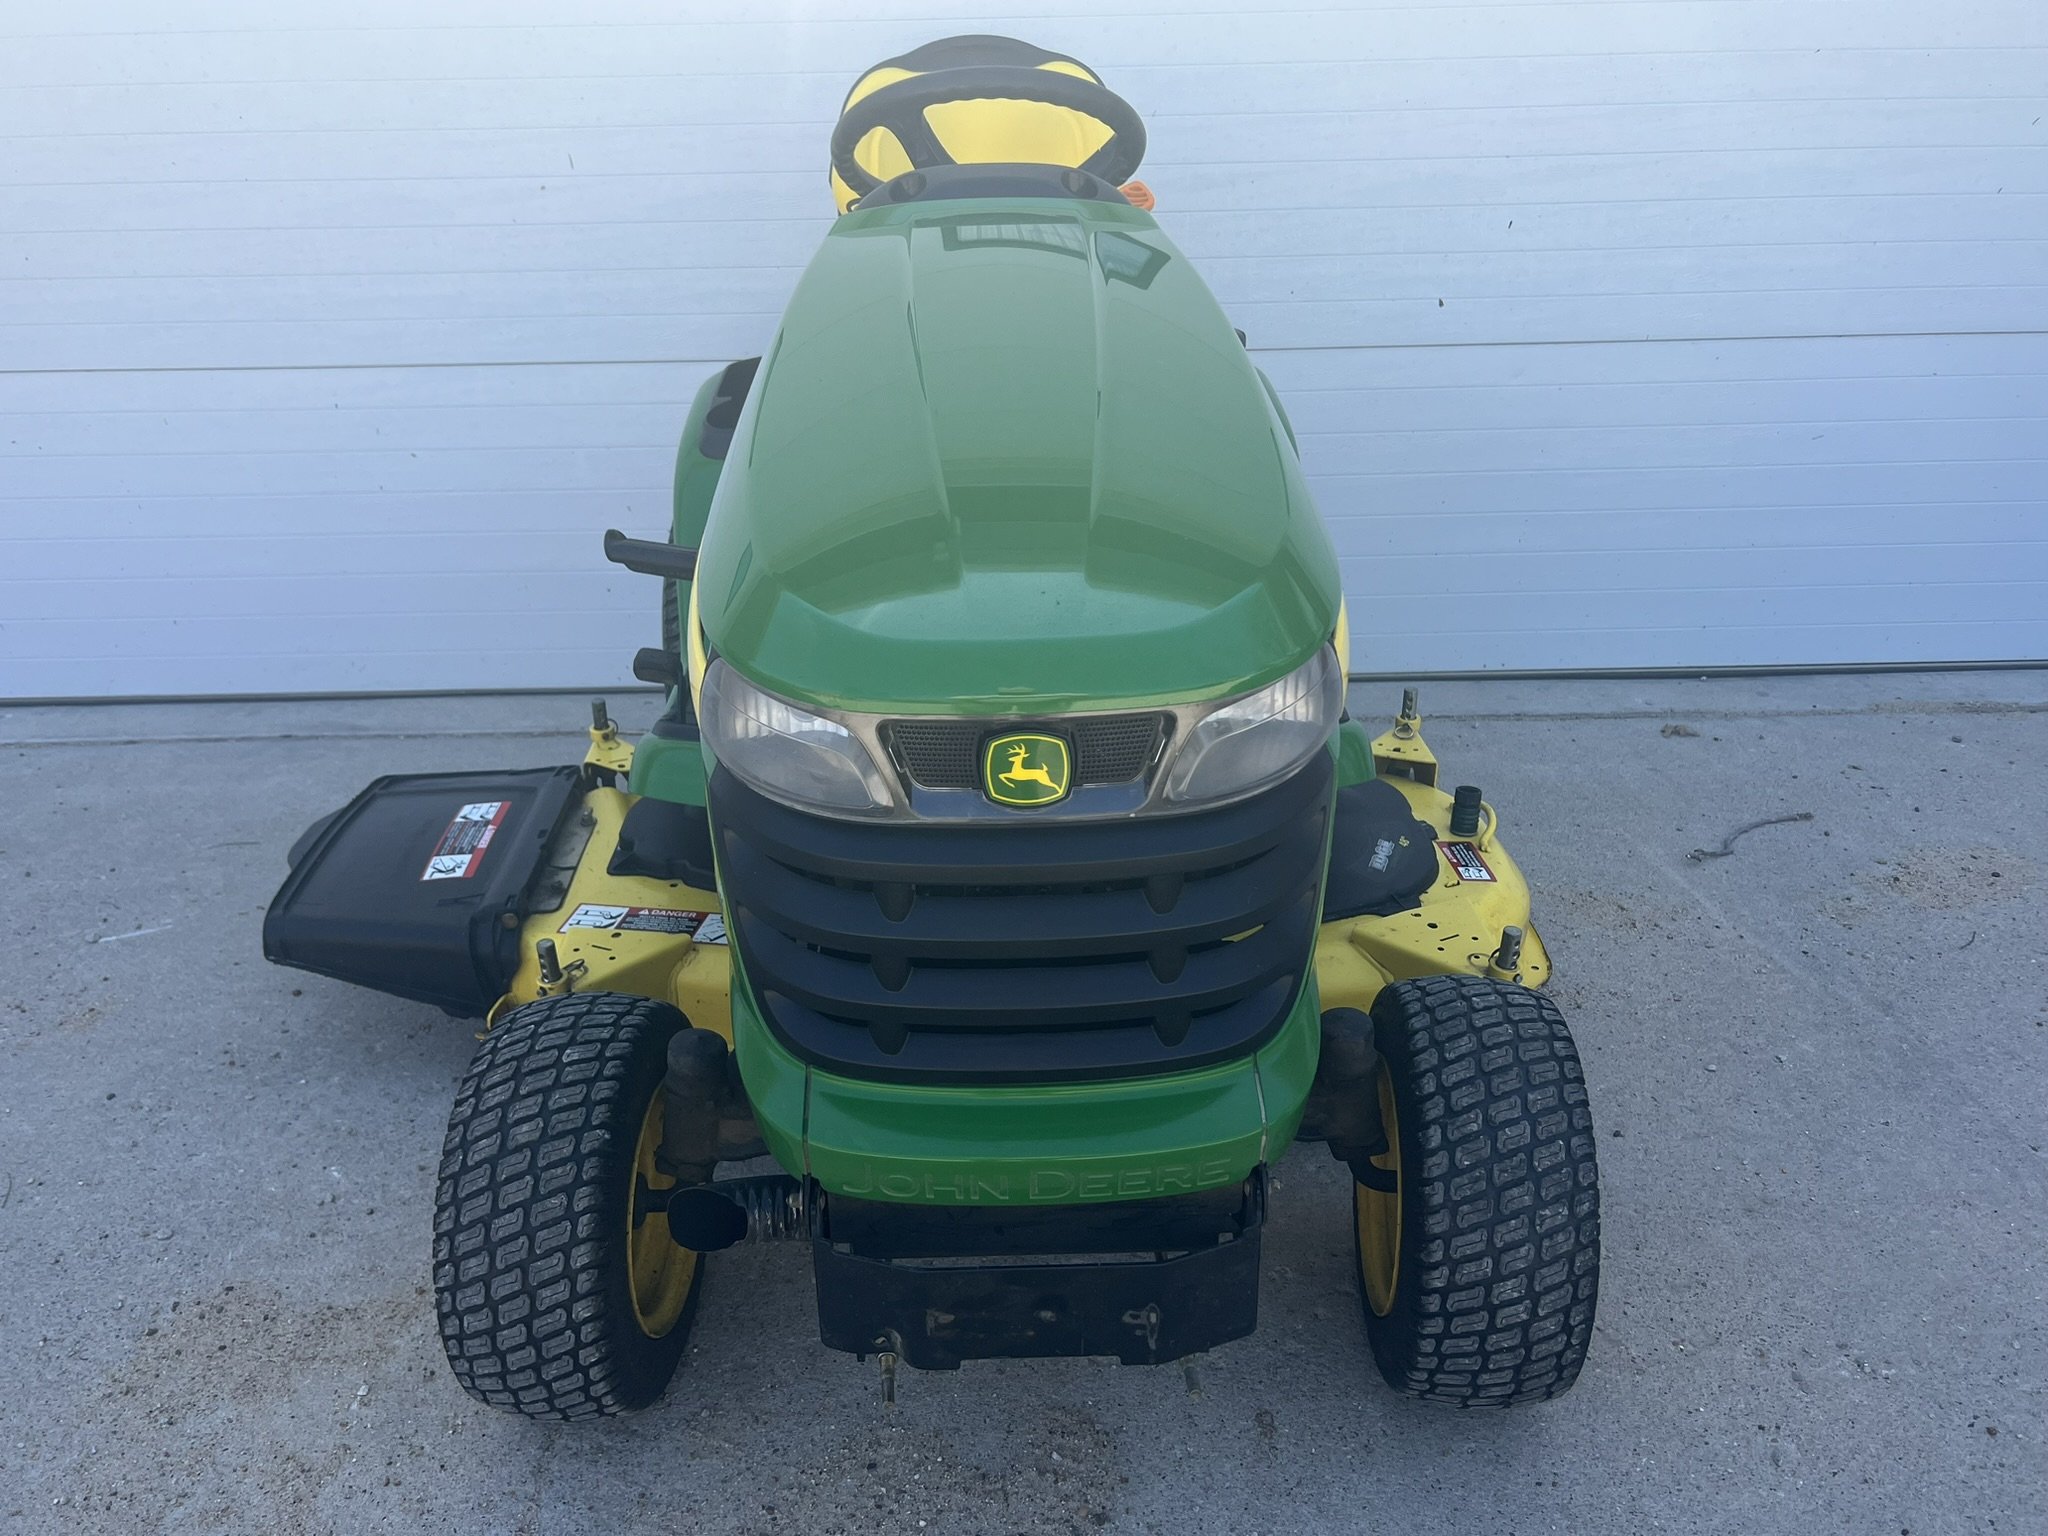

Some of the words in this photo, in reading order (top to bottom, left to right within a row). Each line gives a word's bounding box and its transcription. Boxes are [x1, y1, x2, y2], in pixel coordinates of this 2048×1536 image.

[651, 909, 697, 918] DANGER
[842, 1164, 1009, 1200] JOHN
[1029, 1158, 1232, 1200] DEERE
